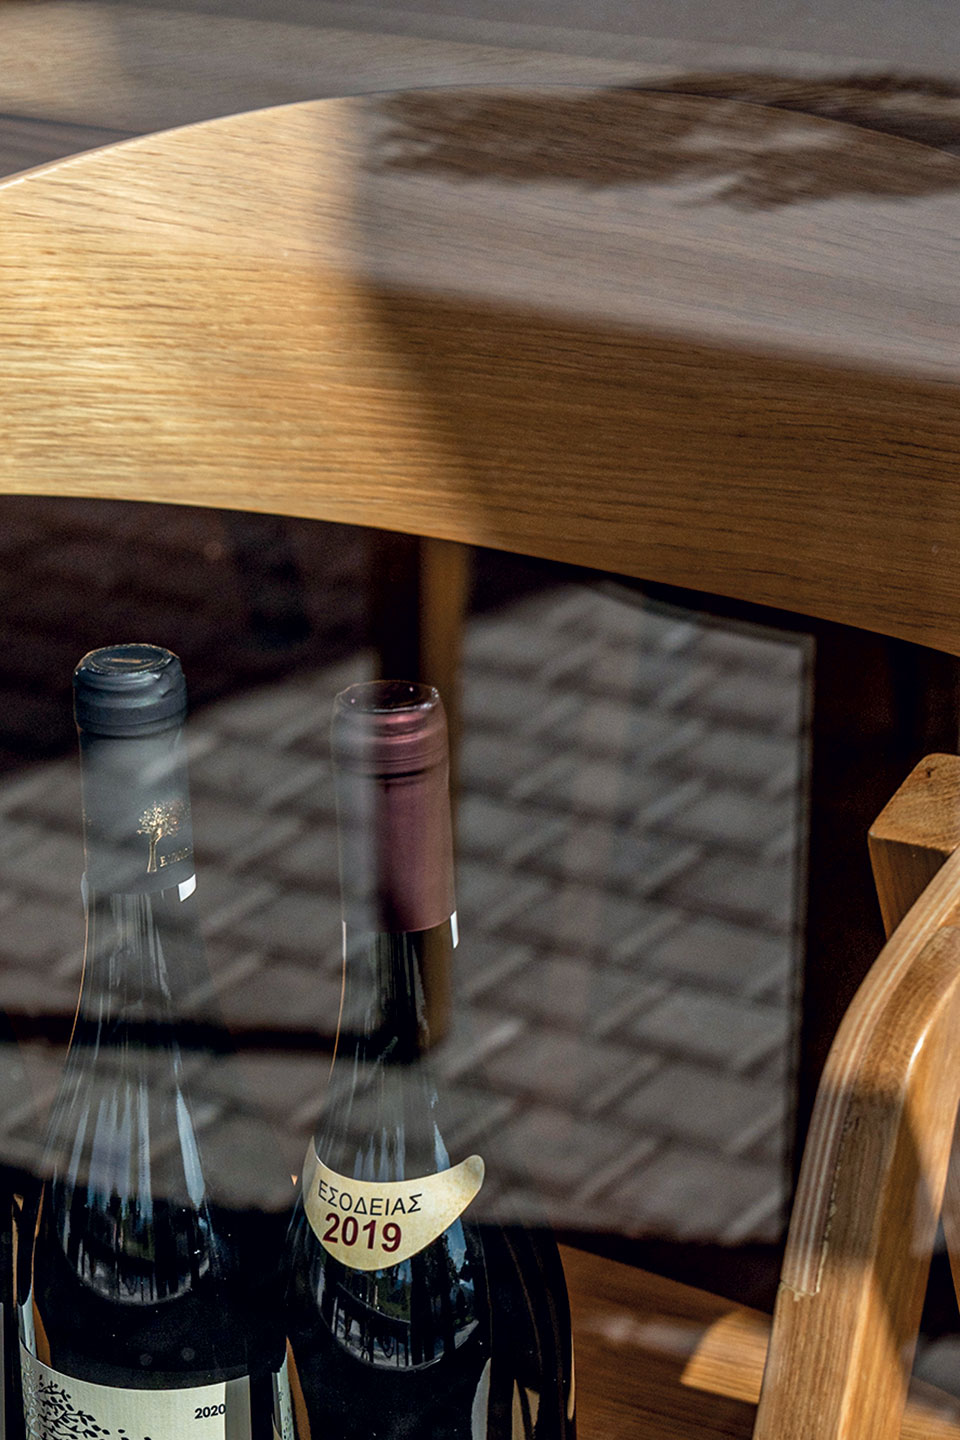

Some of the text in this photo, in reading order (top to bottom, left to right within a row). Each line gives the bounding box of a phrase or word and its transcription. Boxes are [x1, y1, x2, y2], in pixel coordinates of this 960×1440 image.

[318, 1179, 422, 1216] ΕΣΟΔΕΙΑΣ
[323, 1213, 402, 1253] 2019
[194, 1403, 227, 1419] 2020
